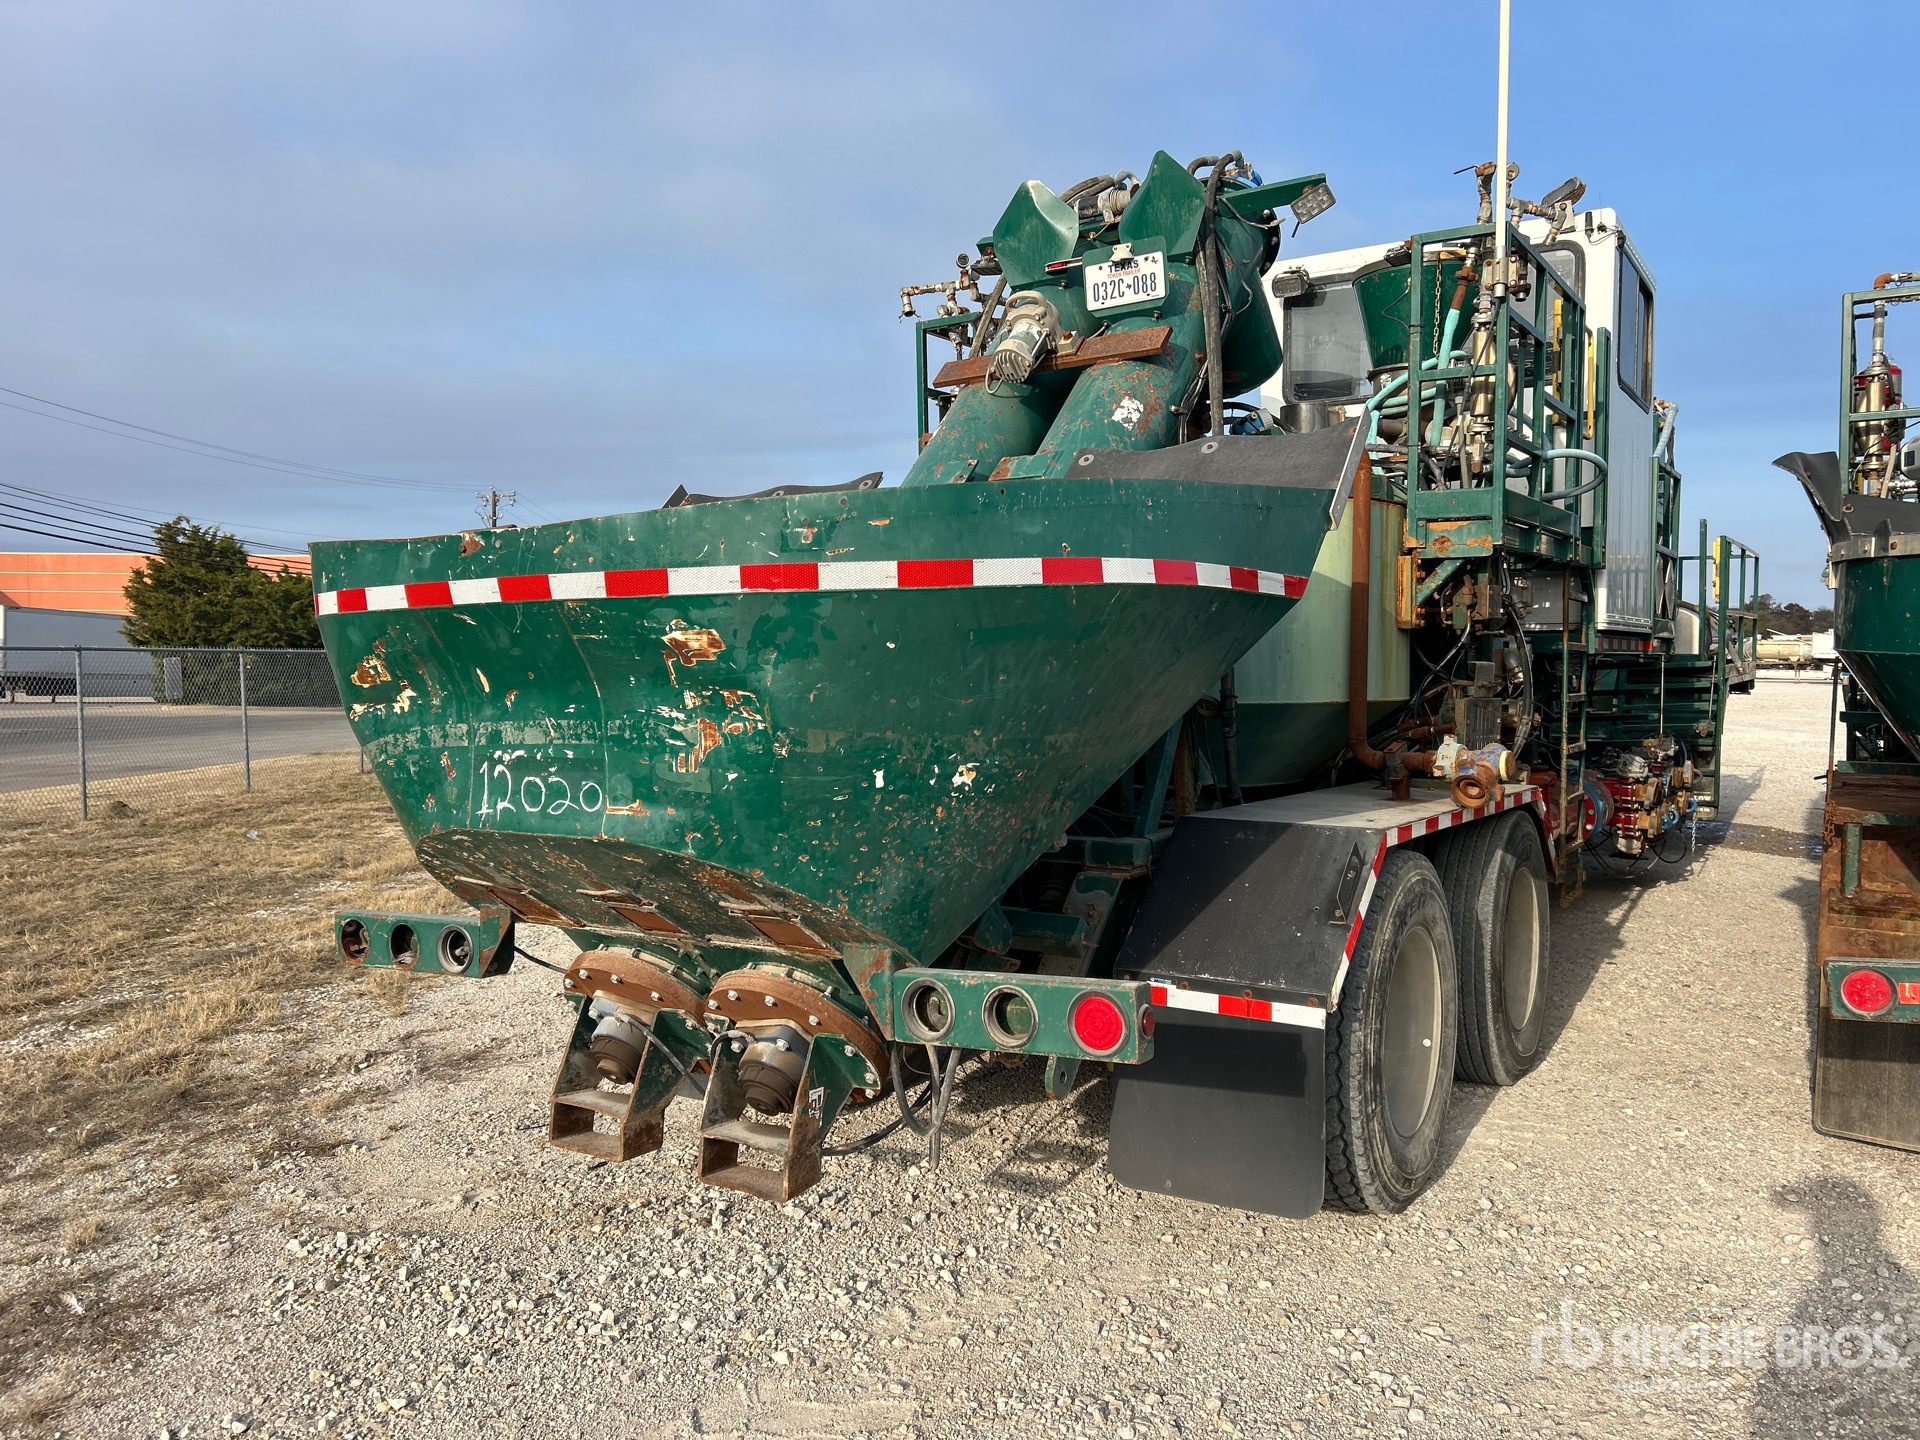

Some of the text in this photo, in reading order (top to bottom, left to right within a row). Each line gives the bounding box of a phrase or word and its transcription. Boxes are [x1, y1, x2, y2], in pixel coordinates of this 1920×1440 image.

[1108, 260, 1139, 273] TEXAS
[1107, 268, 1141, 279] TOKEN TRAILER
[475, 760, 603, 828] 12020
